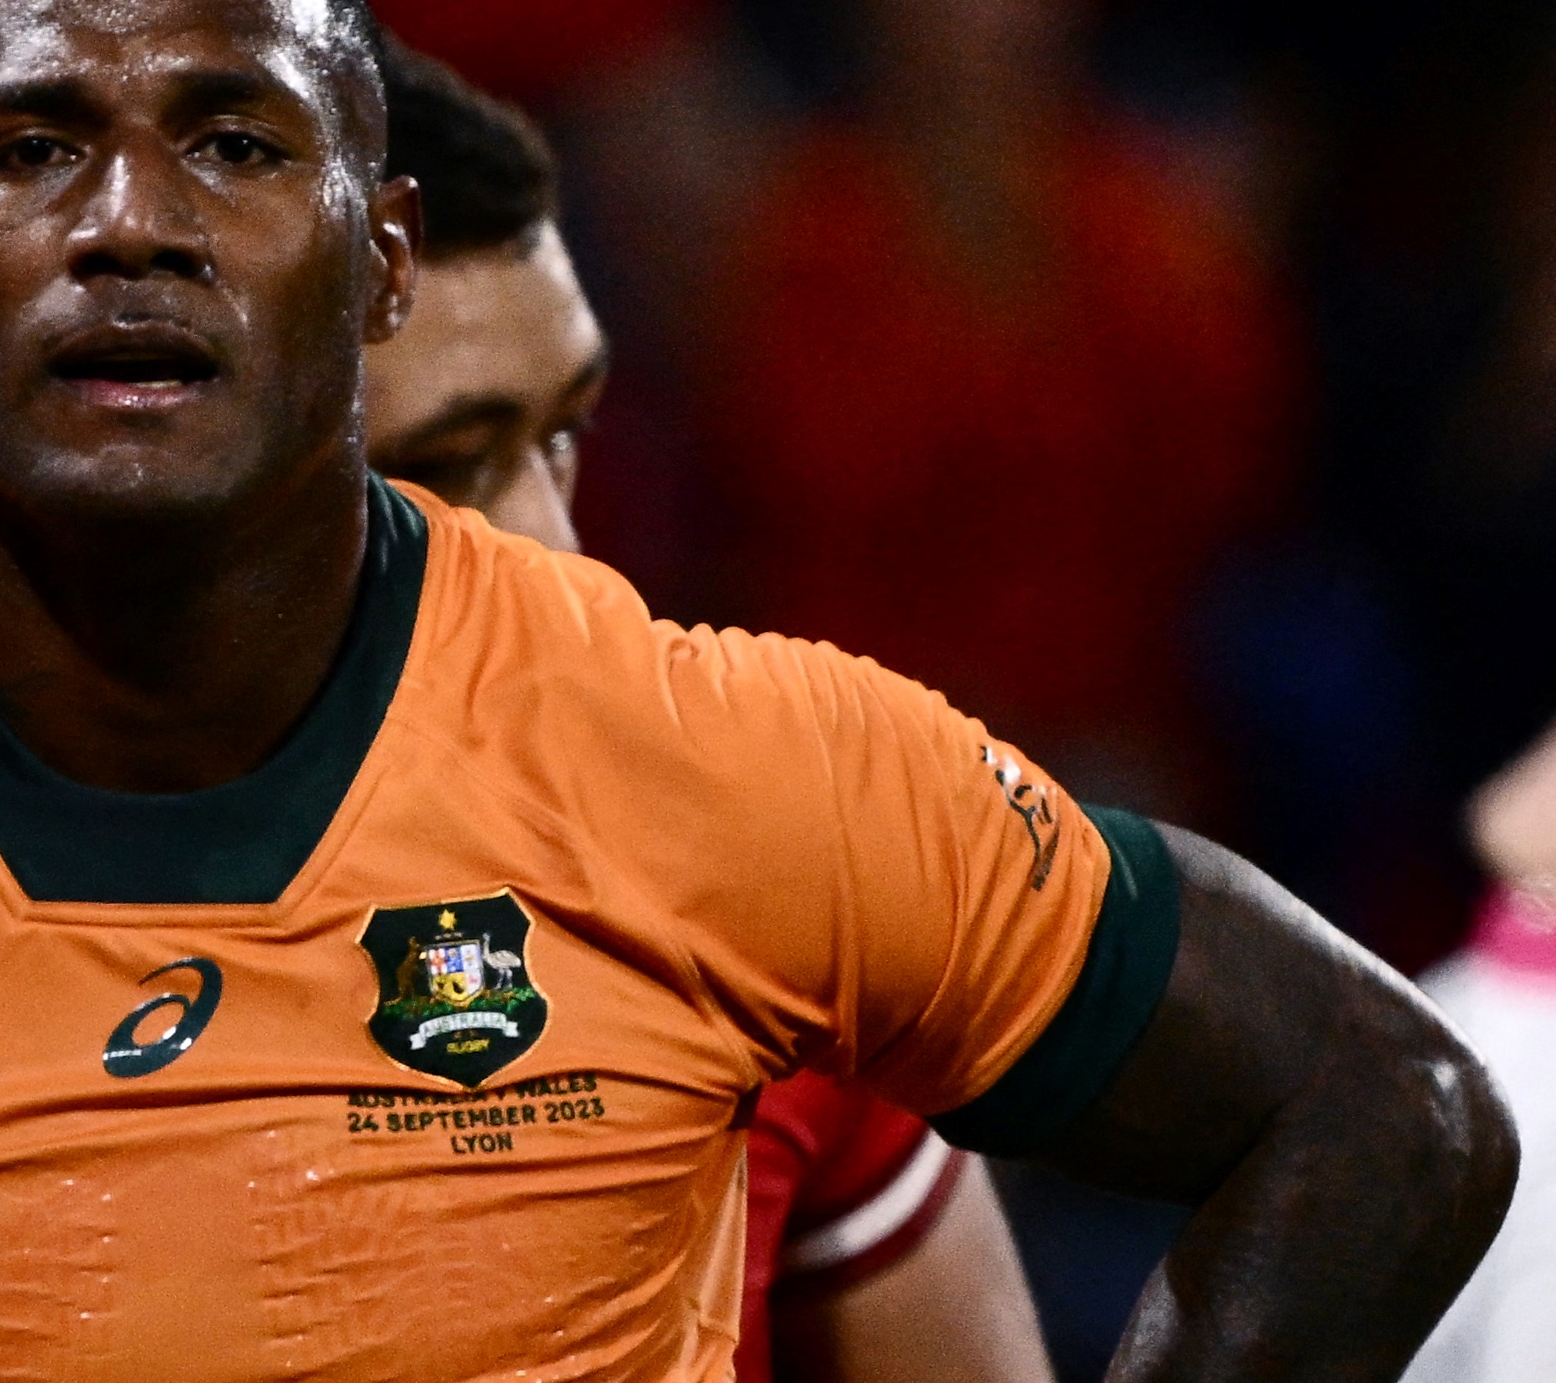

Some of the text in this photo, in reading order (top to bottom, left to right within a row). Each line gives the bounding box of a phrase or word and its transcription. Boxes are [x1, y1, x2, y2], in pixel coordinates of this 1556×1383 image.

[515, 1072, 598, 1098] WALES
[347, 1098, 605, 1133] 24 SEPTEMBER 2023
[450, 1132, 513, 1155] LYON
